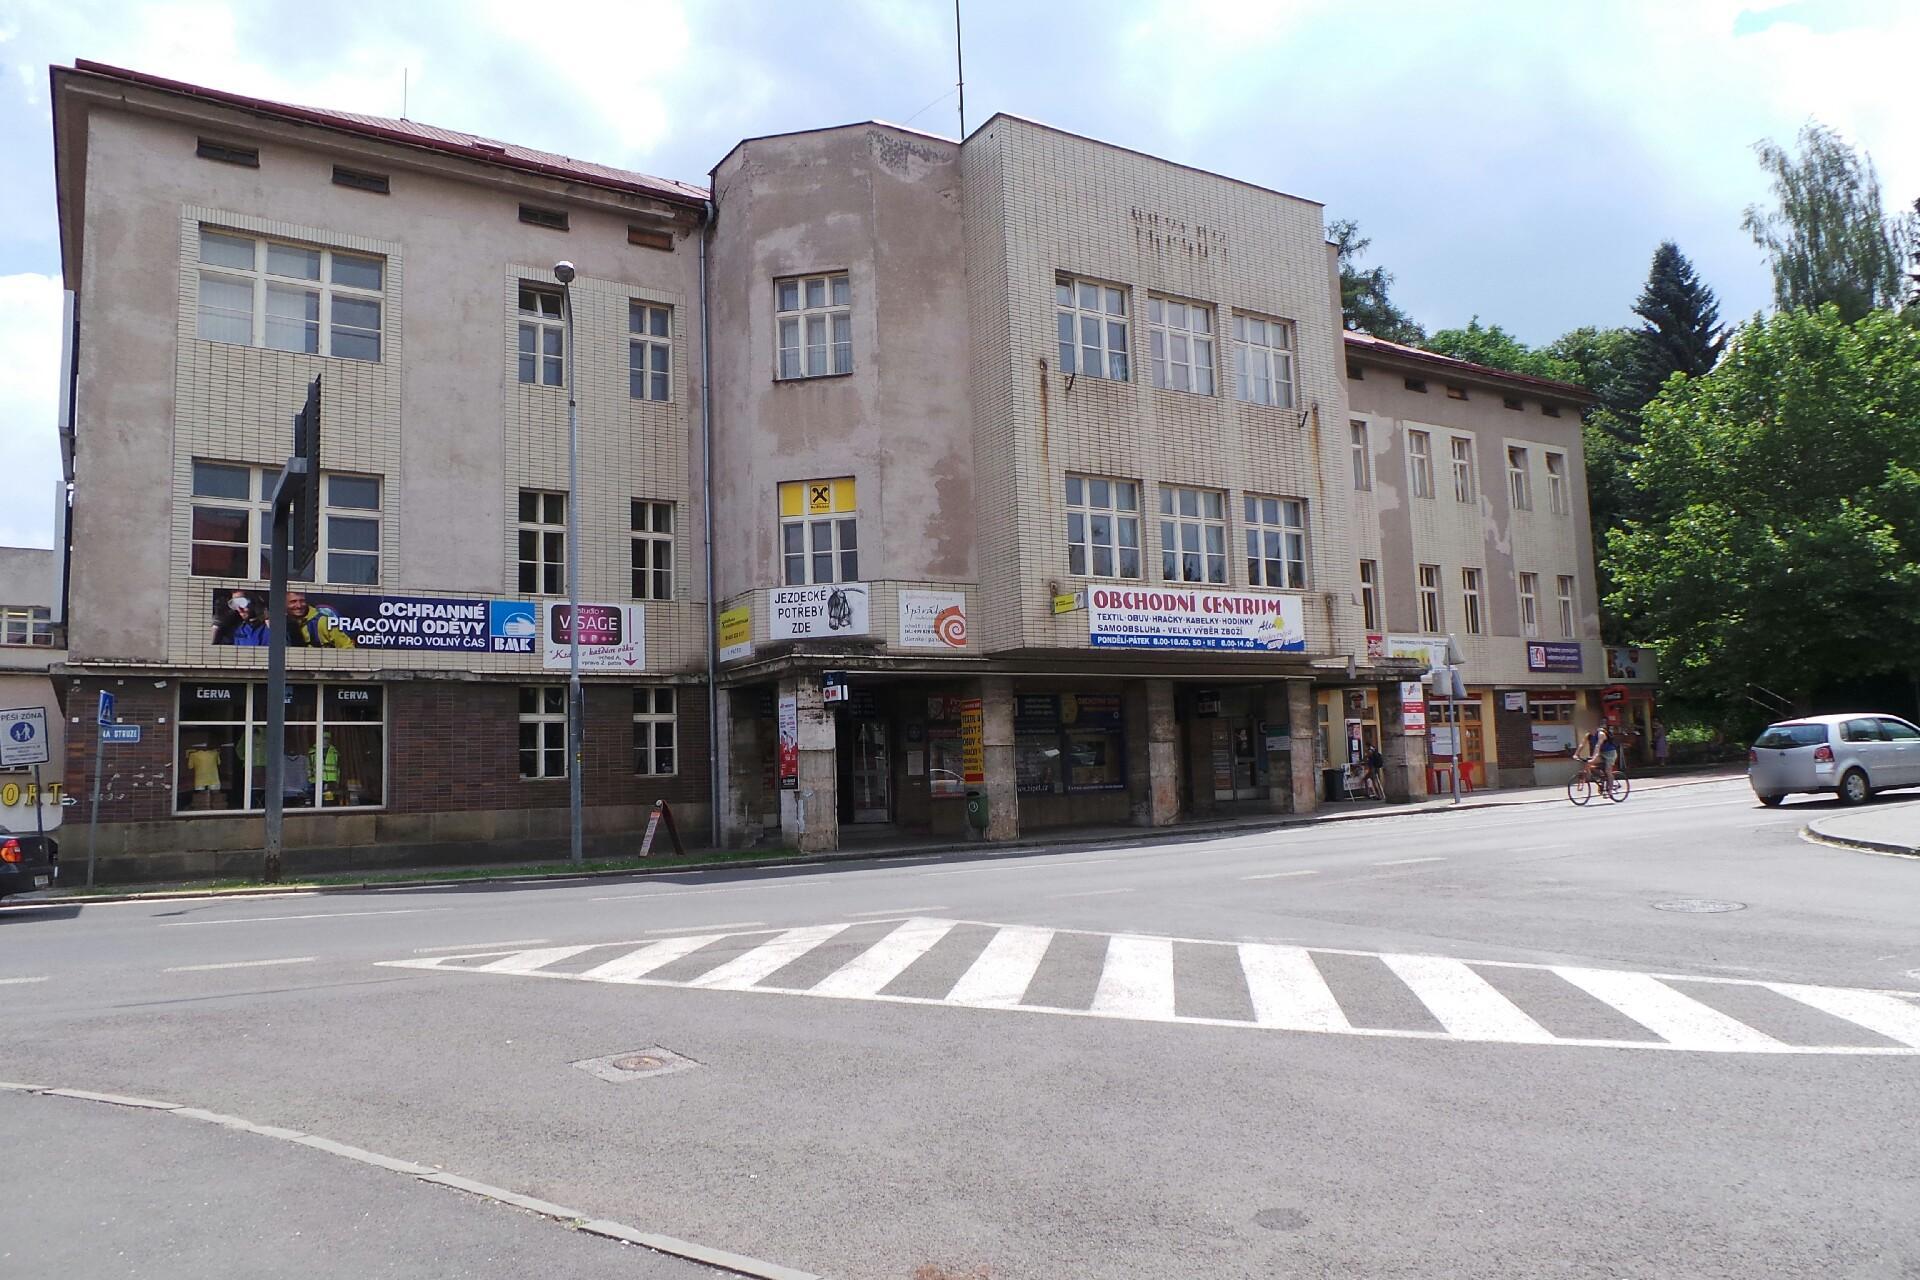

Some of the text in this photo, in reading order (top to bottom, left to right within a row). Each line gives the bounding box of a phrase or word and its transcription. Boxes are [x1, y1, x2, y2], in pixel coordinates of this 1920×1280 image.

[775, 586, 826, 604] JEZDECKÉ
[379, 602, 485, 619] OCHRANNÉ
[1093, 590, 1280, 616] OBCHODNÍ CENTRUM
[778, 603, 824, 619] POTŘEBY
[327, 616, 485, 635] PRACOVNÍ ODĚVY
[559, 615, 618, 631] VSAGE
[1097, 613, 1253, 625] TEXTIL OBUV HRAČKY KABELKY HODINKY
[792, 622, 811, 633] ZDE
[1097, 624, 1160, 633] SAMOOBSLUHA
[1167, 625, 1191, 634] VELKÝ
[1194, 625, 1219, 635] VÝBĚR
[357, 633, 486, 648] ODĚVY PRO VOLNÝ ČAS
[494, 637, 531, 652] BMK
[196, 686, 231, 699] ČERVA
[337, 688, 369, 700] ČERVA
